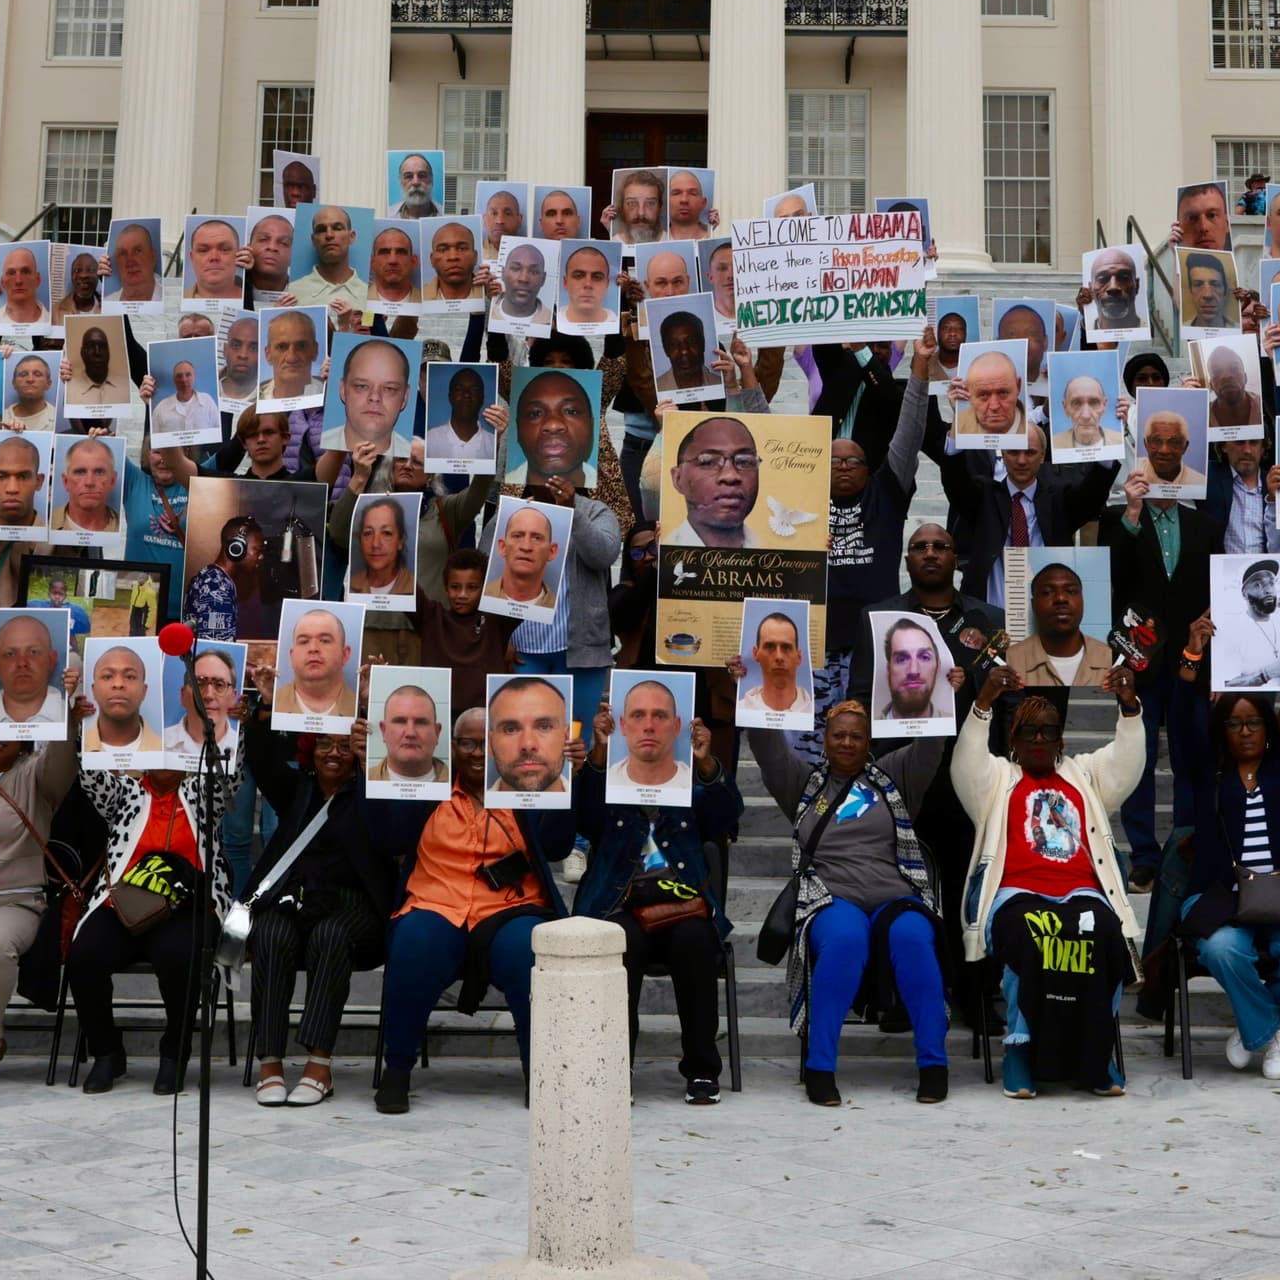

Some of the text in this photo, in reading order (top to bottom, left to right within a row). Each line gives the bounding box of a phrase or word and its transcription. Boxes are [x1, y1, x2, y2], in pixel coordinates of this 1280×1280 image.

[732, 212, 921, 246] WELCOME TO ALABAMA
[734, 251, 779, 274] Where
[786, 256, 814, 268] there
[819, 250, 829, 265] is
[736, 276, 761, 297] but
[766, 277, 799, 293] there
[806, 274, 818, 289] is
[737, 286, 927, 329] MEDICAID EXPANSION
[785, 440, 824, 457] Loving
[770, 455, 817, 474] Memory
[700, 550, 754, 572] Roderick
[757, 551, 820, 574] Dewayne
[700, 568, 784, 588] ABRAMS
[1024, 910, 1063, 938] NO
